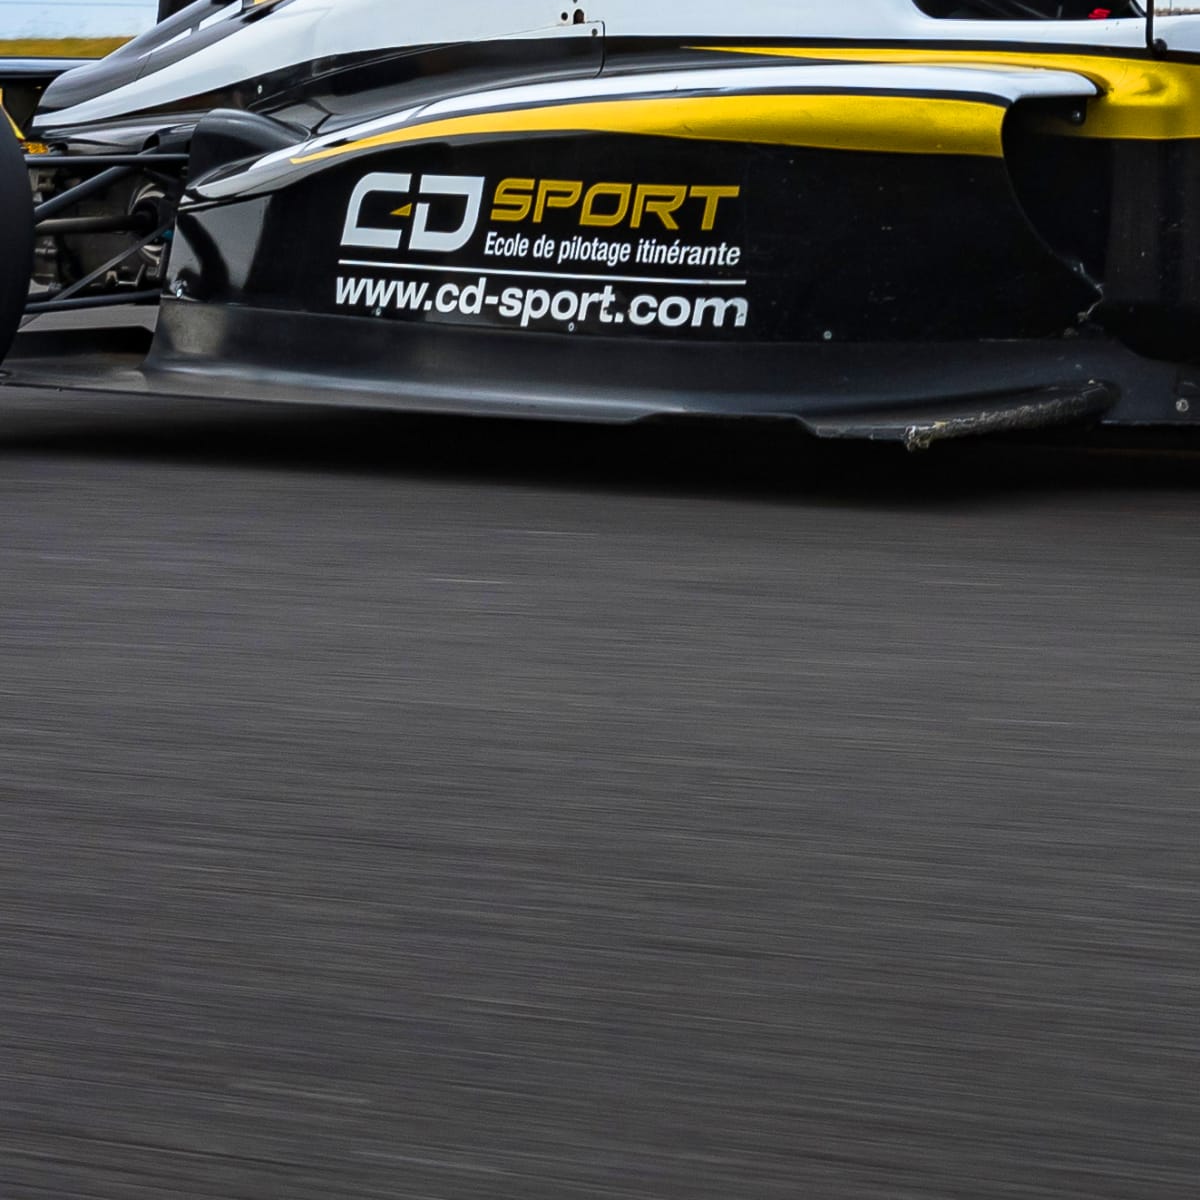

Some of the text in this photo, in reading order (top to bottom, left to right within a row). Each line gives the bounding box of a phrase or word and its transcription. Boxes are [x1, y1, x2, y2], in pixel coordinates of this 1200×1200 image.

[340, 172, 740, 252] CD SPORT
[484, 231, 741, 266] Ecole de pilotage itinérante
[336, 276, 748, 327] www.cd-sport.com
